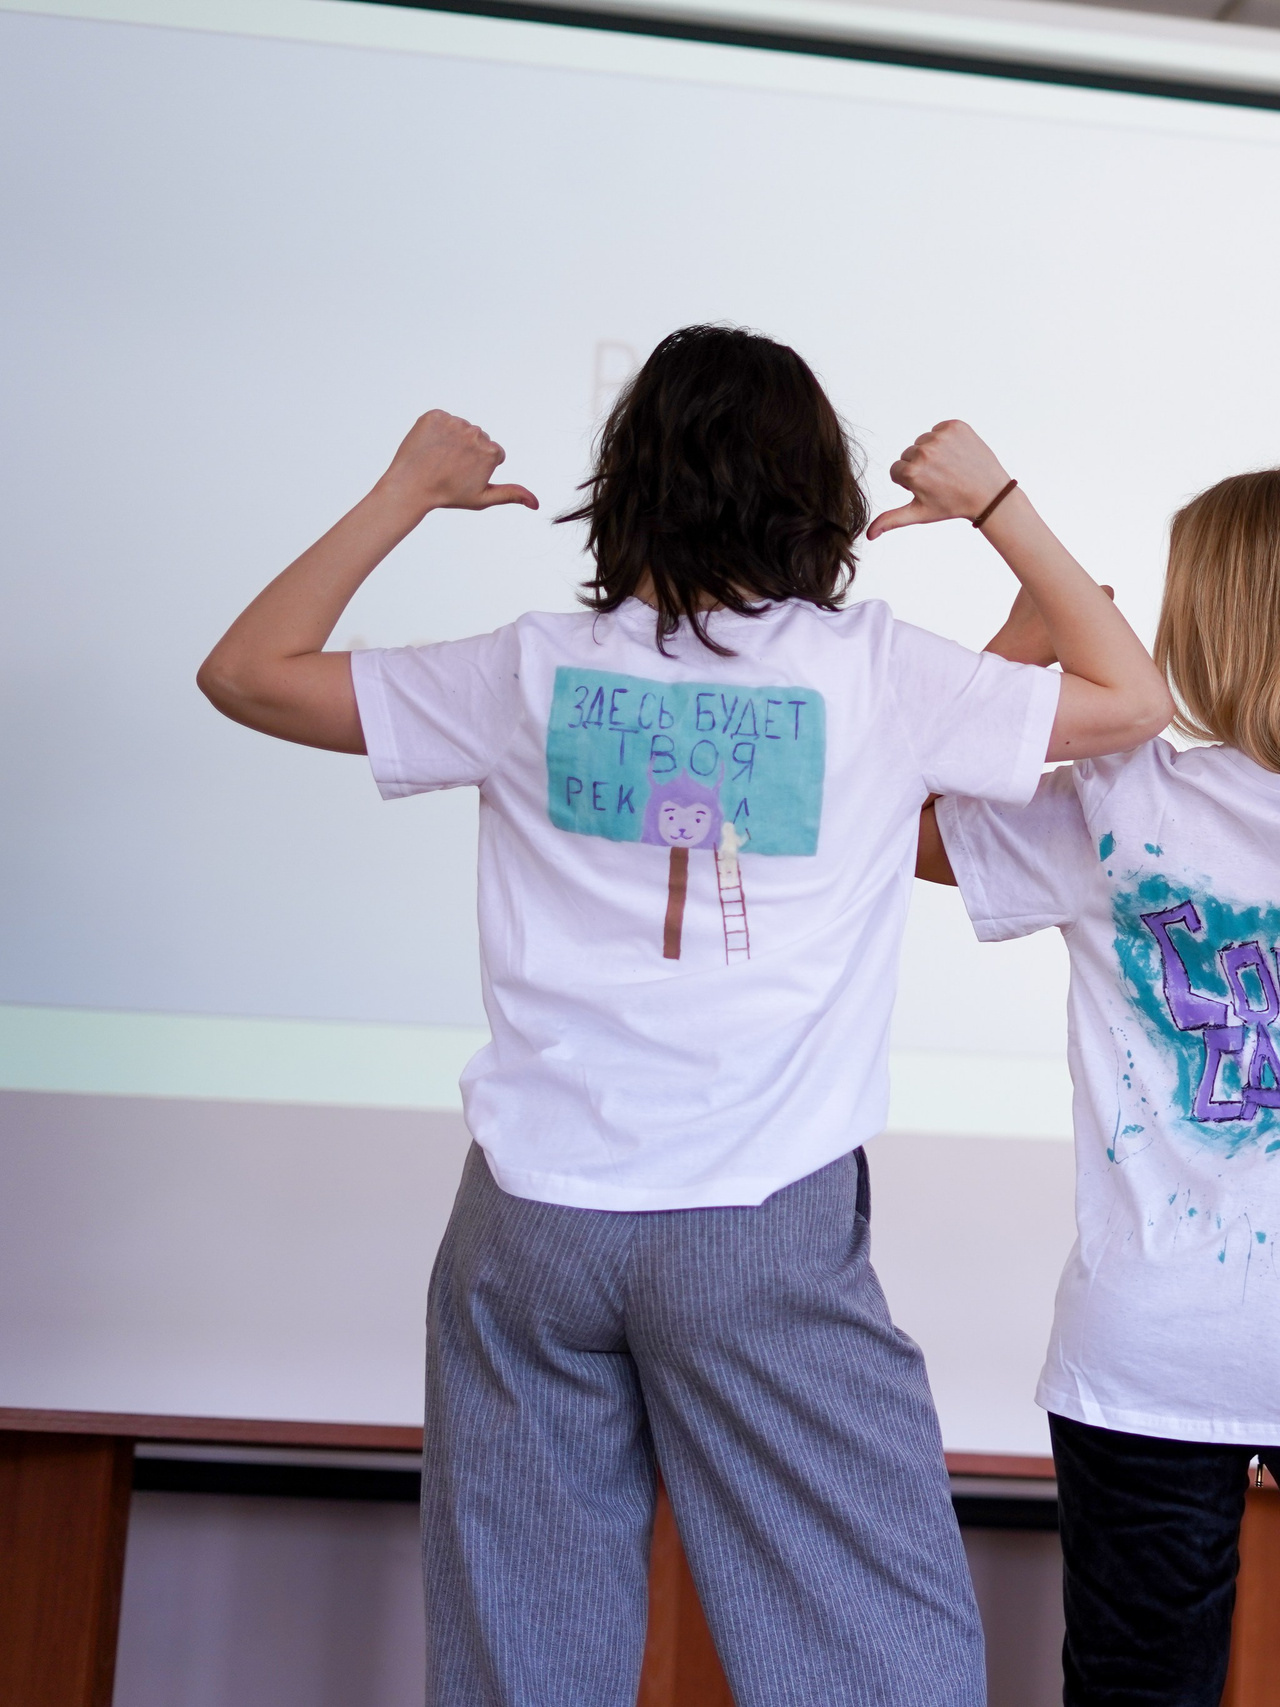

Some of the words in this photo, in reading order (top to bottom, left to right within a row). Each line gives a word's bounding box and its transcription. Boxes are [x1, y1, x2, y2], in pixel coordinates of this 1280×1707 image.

[568, 685, 675, 730] ЗДЕСЬ
[696, 692, 808, 741] БУДЕТ
[608, 727, 757, 783] ТВОЯ
